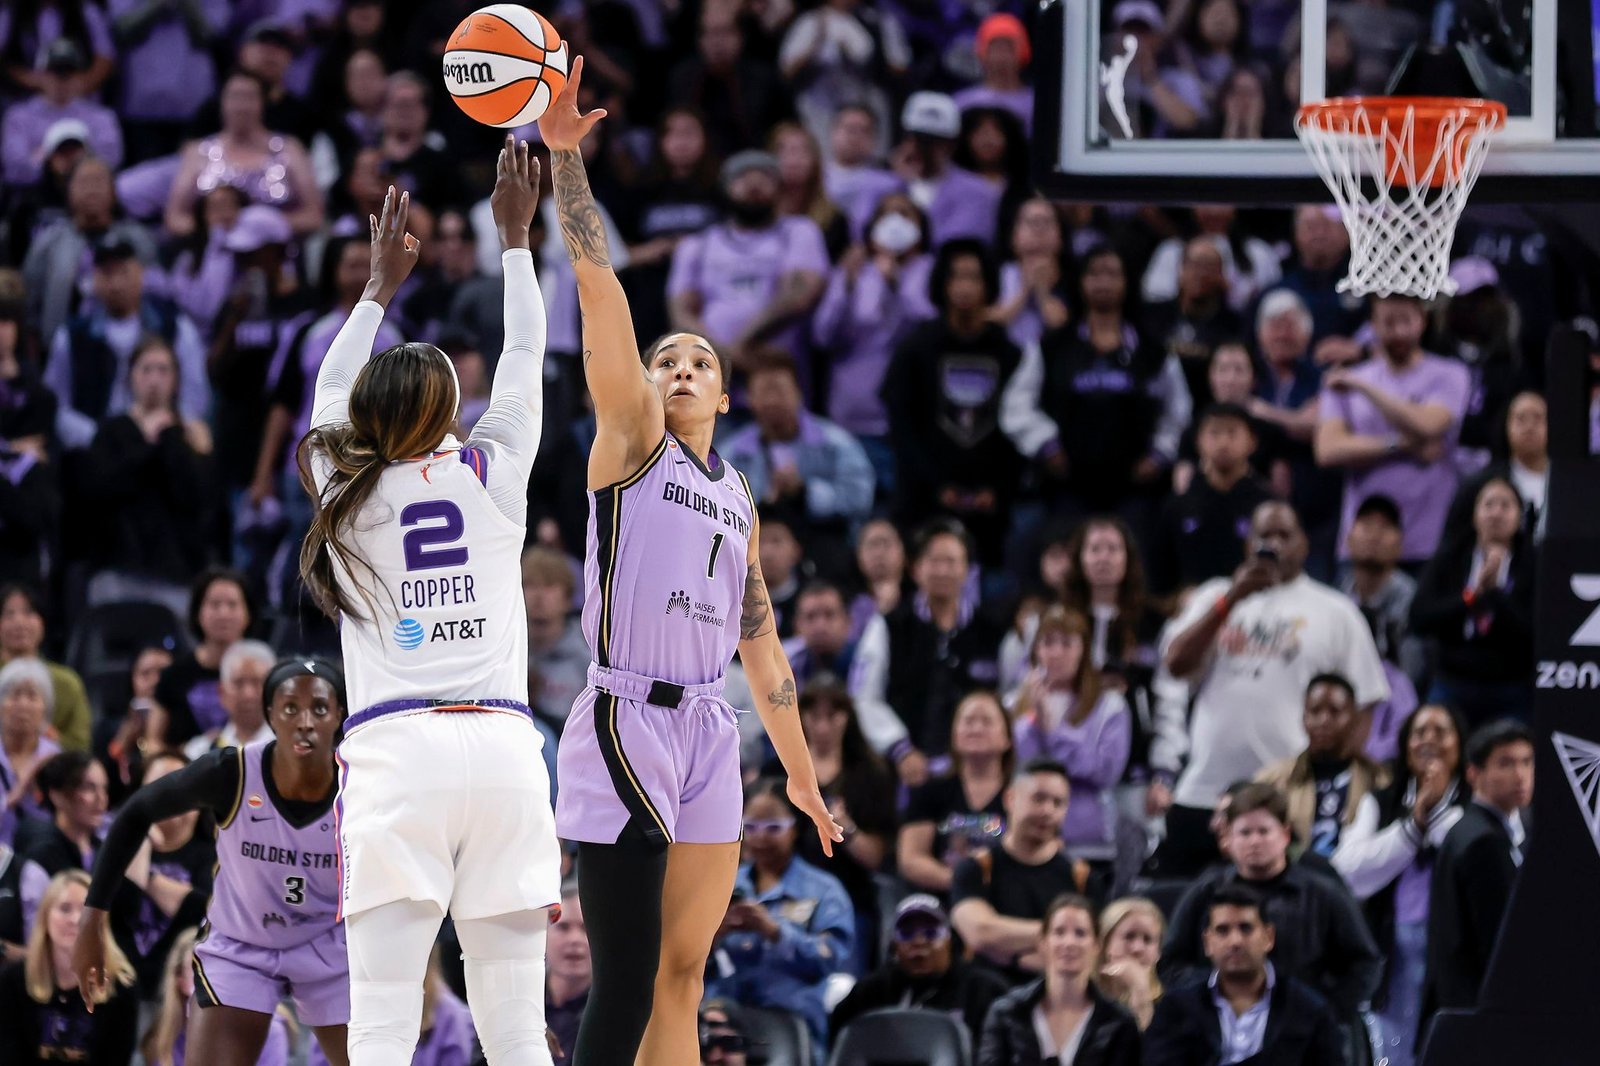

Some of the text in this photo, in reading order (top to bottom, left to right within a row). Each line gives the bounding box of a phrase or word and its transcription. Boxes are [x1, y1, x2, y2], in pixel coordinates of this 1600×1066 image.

[662, 482, 718, 520] GOLDEN
[400, 499, 470, 571] 2
[705, 530, 726, 581] 1
[401, 574, 476, 609] COPPER
[694, 601, 717, 614] KAISER
[430, 617, 486, 643] AT&T
[241, 841, 298, 867] GOLDEN
[284, 875, 306, 906] 3
